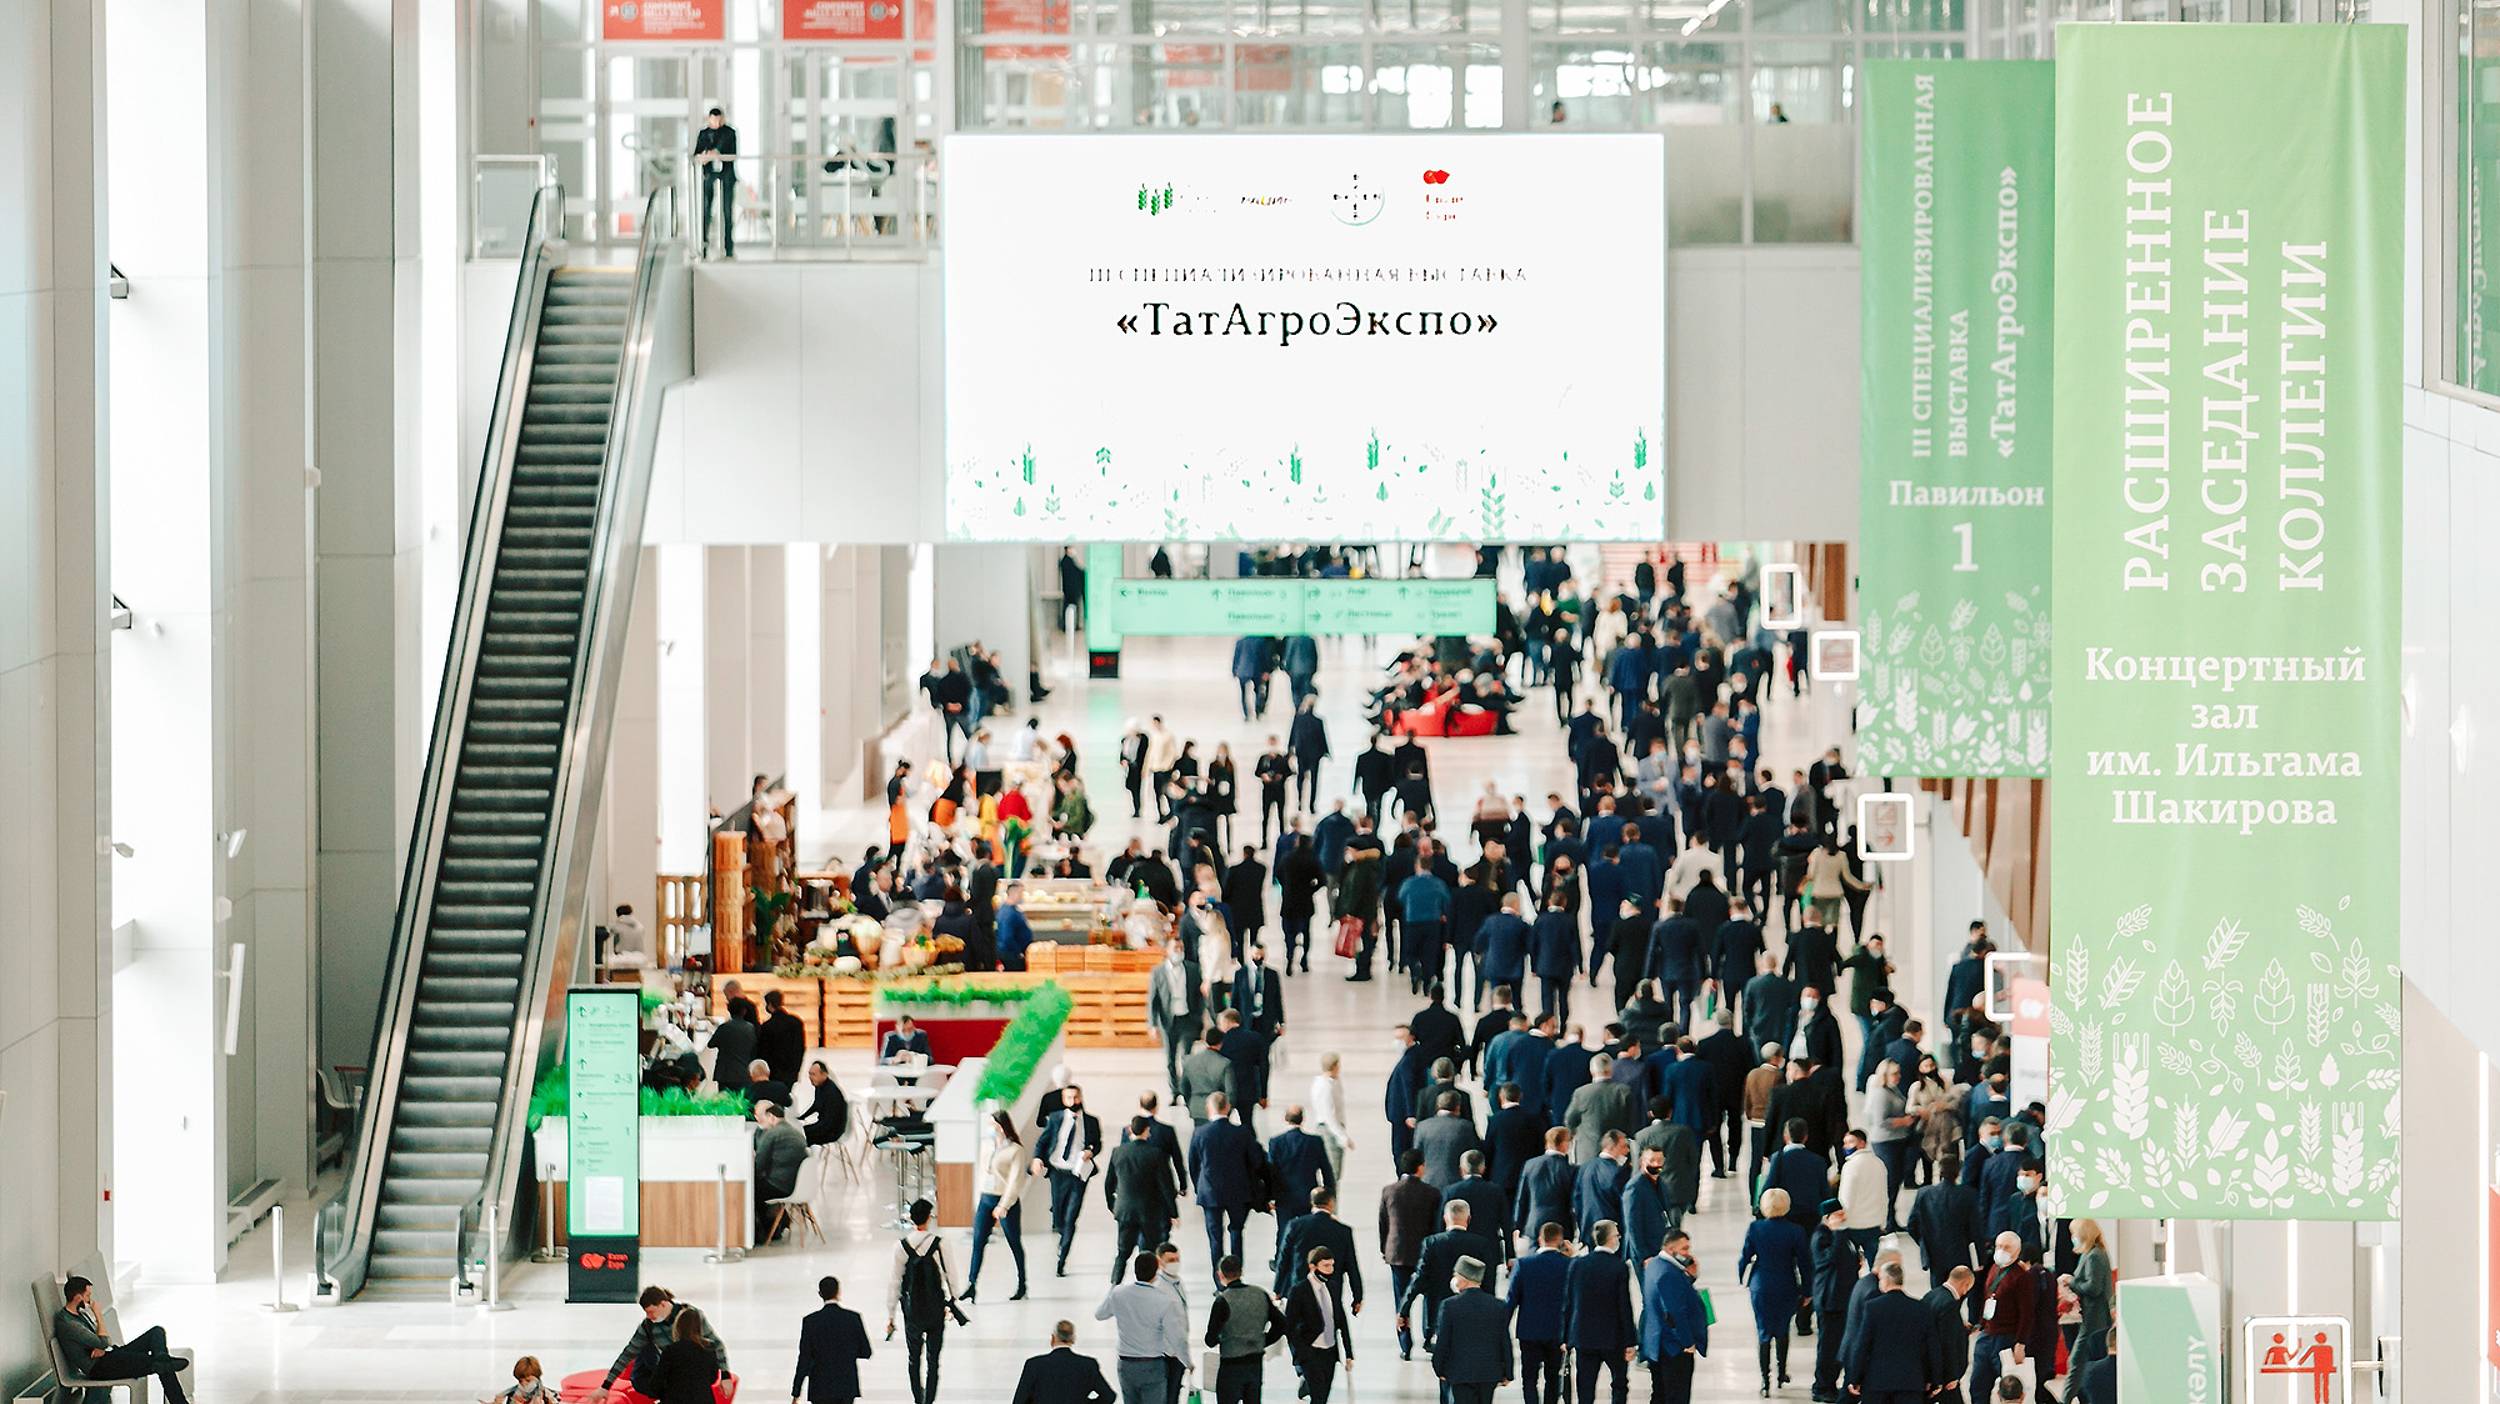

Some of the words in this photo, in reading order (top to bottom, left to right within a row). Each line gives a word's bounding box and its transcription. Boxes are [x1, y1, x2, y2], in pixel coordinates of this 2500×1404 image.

[1912, 74, 1936, 422] СПЕЦИАЛИЗИРОВАННАЯ
[1116, 302, 1498, 347] «ТатАгроЭкспо»
[1989, 166, 2025, 458] «ТатАгроЭкспо»
[2123, 92, 2173, 592] РАСШИРЕННОЕ
[1948, 309, 1969, 457] ВЫСТАВКА
[2200, 209, 2260, 593] ЗАСЕДАНИЕ
[2278, 241, 2327, 592] КОЛЛЕГИИ
[1912, 428, 1932, 458] III
[1889, 480, 2045, 506] Павильон
[1952, 522, 1979, 572] 1
[2085, 646, 2366, 693] Концертный
[2191, 703, 2259, 730] зал
[2087, 751, 2162, 777] им.
[2175, 742, 2363, 777] Ильгама
[2111, 789, 2338, 836] Шакирова
